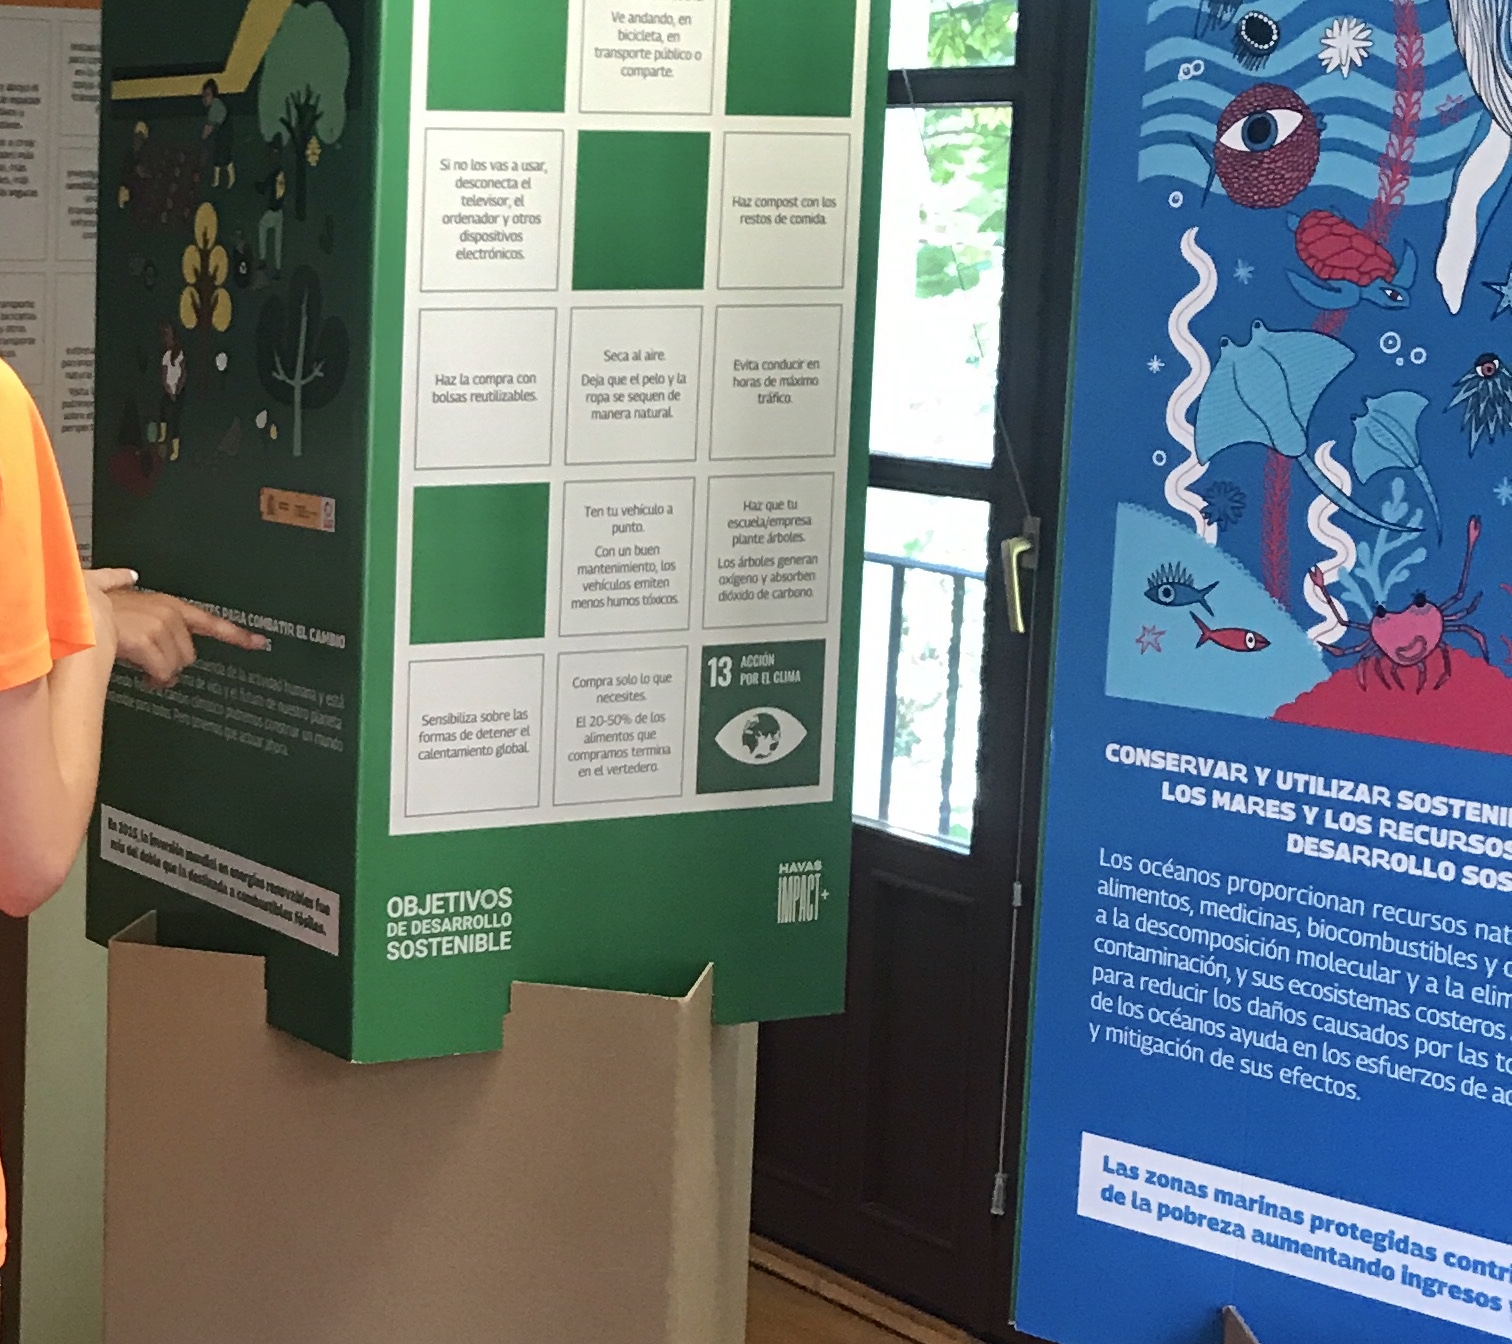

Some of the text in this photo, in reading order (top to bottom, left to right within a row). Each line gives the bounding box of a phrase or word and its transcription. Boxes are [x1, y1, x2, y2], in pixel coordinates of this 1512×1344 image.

[611, 11, 626, 24] Ve
[677, 15, 692, 26] en
[666, 32, 681, 43] en
[594, 47, 702, 62] transporte público o
[440, 158, 451, 171] Si
[453, 161, 468, 171] no
[470, 158, 488, 171] los
[489, 161, 509, 172] vas
[511, 161, 519, 172] a
[455, 176, 532, 190] desconecta el
[513, 194, 525, 207] el
[442, 212, 542, 227] ordenador y otros
[459, 229, 524, 245] dispositivos
[435, 373, 537, 388] Haz la compra con
[432, 391, 468, 404] bolsas
[740, 651, 775, 668] ACCIÓN
[707, 656, 732, 688] 13
[739, 670, 801, 686] POR EL CLIMA
[421, 708, 529, 727] Sensibiliza sobre las
[418, 725, 531, 743] formas de detener el
[417, 745, 494, 761] calentamiento
[1105, 743, 1512, 828] CONSERVAR Y UTILIZAR SOSTENI
[1161, 781, 1512, 861] LOS MARES Y LOS RECURSOS
[778, 859, 823, 874] HAVAS
[1286, 833, 1512, 892] DESARROLLO SOS
[387, 887, 513, 918] OBJETIVOS
[1099, 847, 1512, 946] Los océanos proporcionan recursos nat
[386, 911, 512, 938] DE DESARROLLO
[1097, 877, 1194, 917] alimentos,
[1200, 900, 1301, 939] medicinas,
[1307, 916, 1478, 970] biocombustibles
[1484, 956, 1498, 979] y
[386, 930, 512, 961] SOSTENIBLE
[1095, 908, 1108, 925] a
[1112, 906, 1130, 929] la
[1135, 913, 1290, 963] descomposición
[1296, 949, 1401, 985] molecular
[1406, 972, 1420, 994] y
[1425, 976, 1439, 995] a
[1445, 975, 1465, 1000] la
[1094, 937, 1506, 1040] contaminación, y sus ecosistemas costeros
[1092, 966, 1489, 1068] para reducir los daños causados por las
[1090, 991, 1488, 1100] de los océanos ayuda en los esfuerzos de
[1089, 1022, 1361, 1101] y mitigación de sus efectos.
[1102, 1155, 1140, 1180] Las
[1144, 1169, 1209, 1199] zonas
[1213, 1188, 1305, 1226] marinas
[1309, 1214, 1437, 1262] protegidas
[1100, 1184, 1503, 1312] de la pobreza aumentando ingresos
